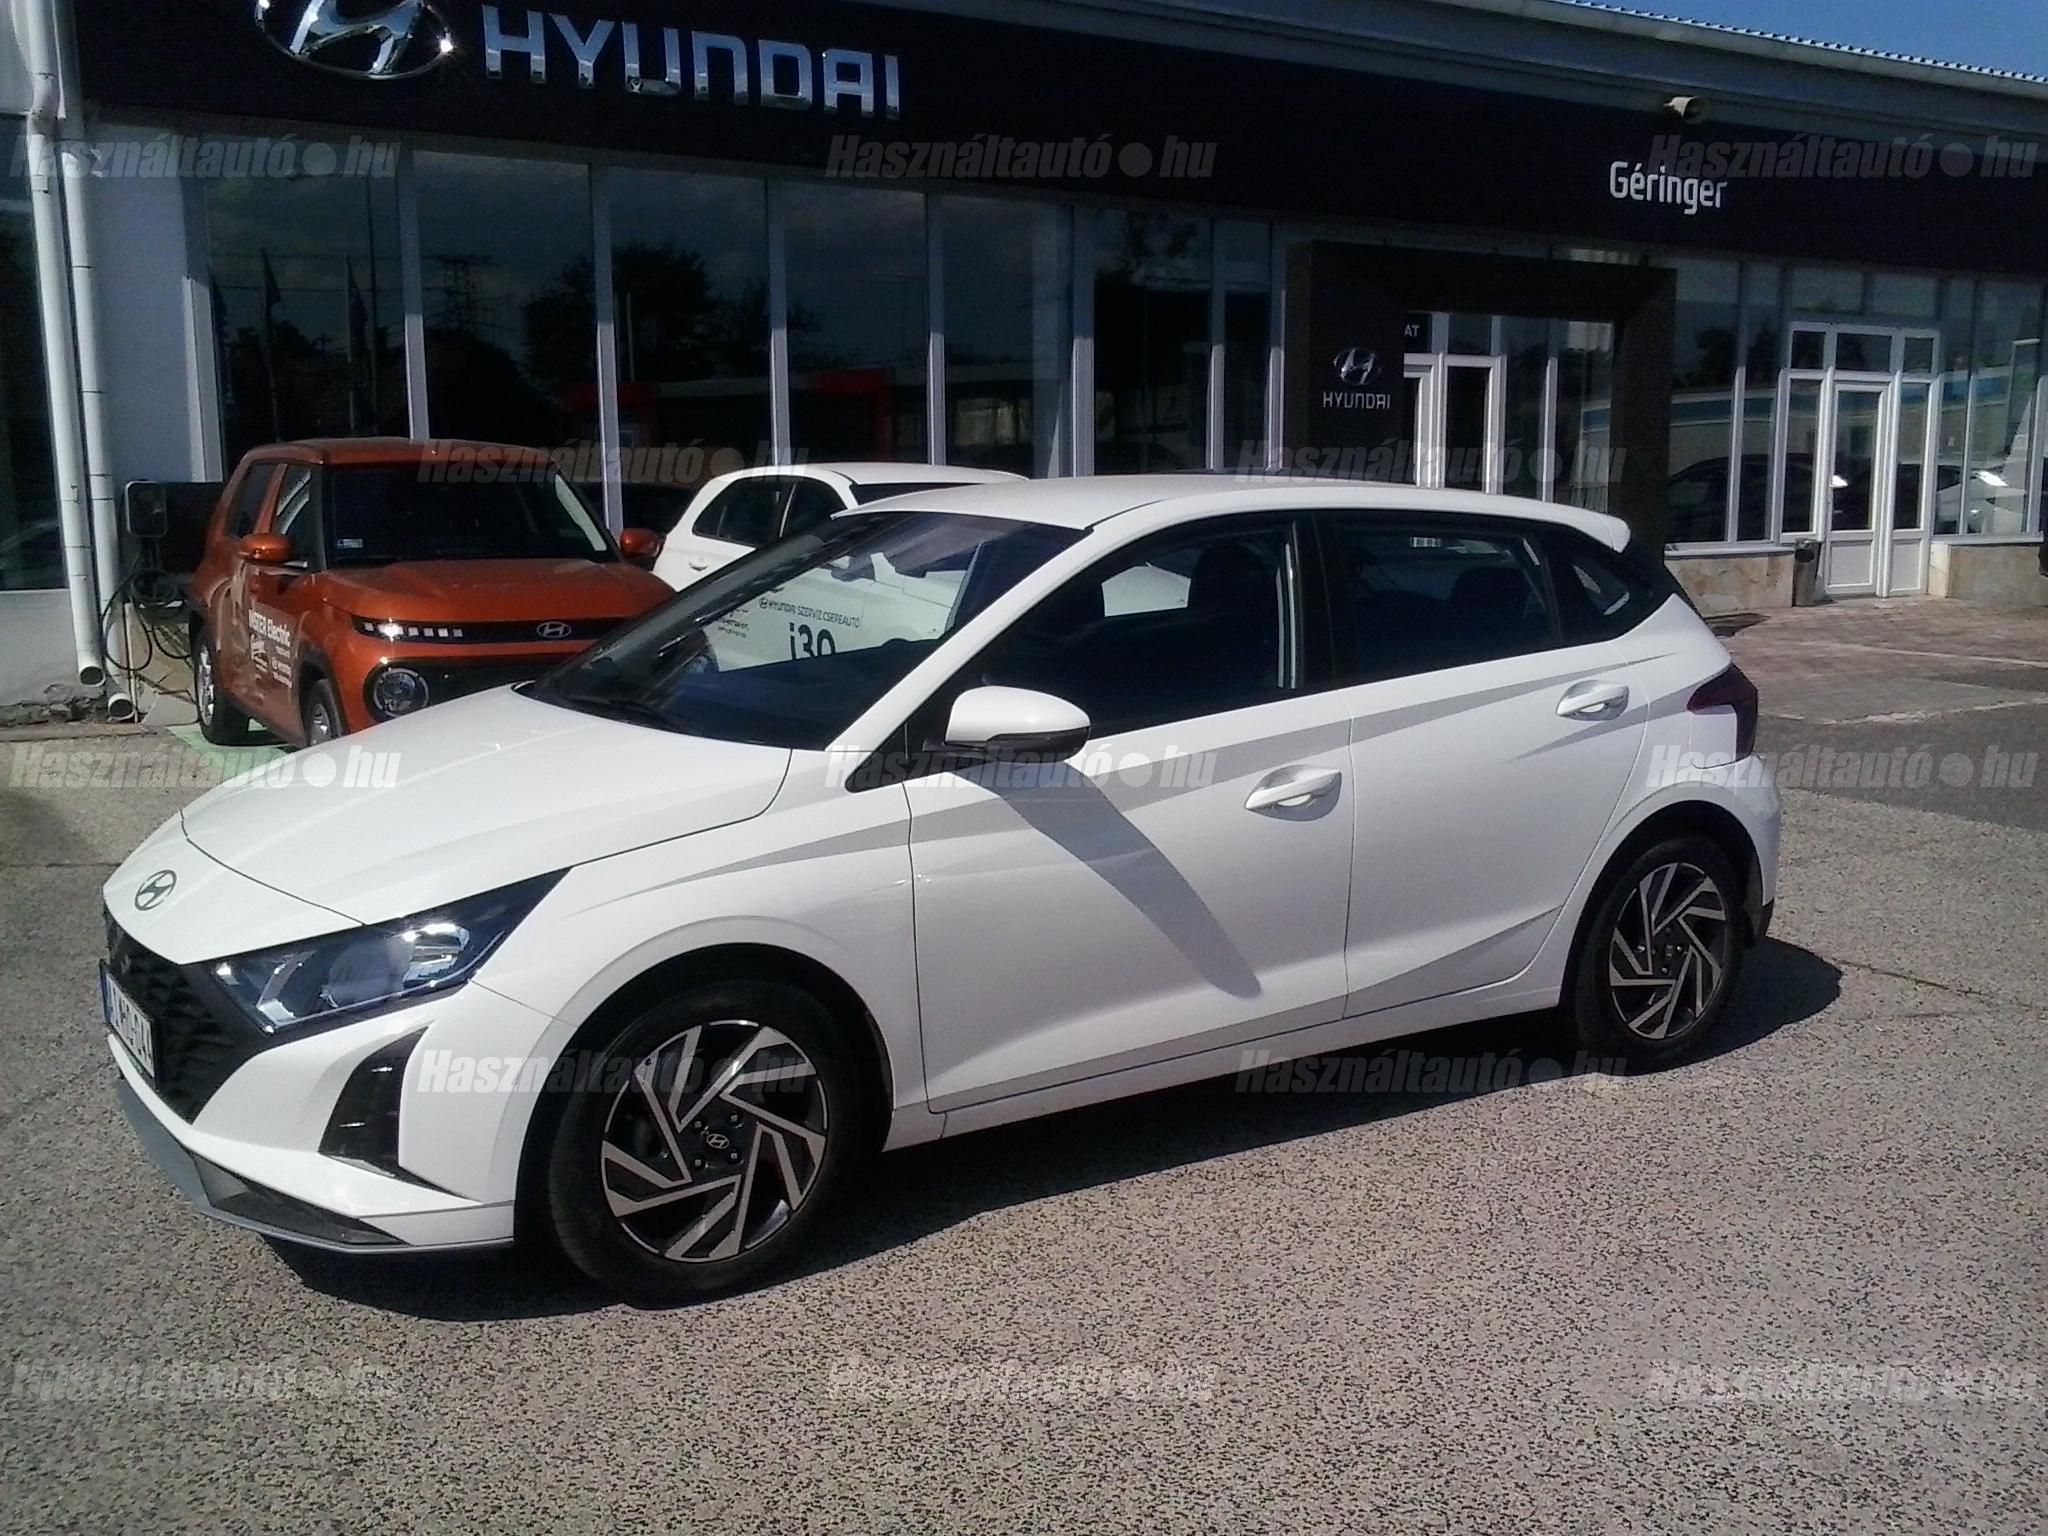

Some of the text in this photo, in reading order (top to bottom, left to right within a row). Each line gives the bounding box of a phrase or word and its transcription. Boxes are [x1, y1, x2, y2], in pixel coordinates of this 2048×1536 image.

[482, 3, 900, 120] HYUNDAI
[1609, 160, 1728, 215] Géringer
[1322, 392, 1391, 409] HYUNDAI
